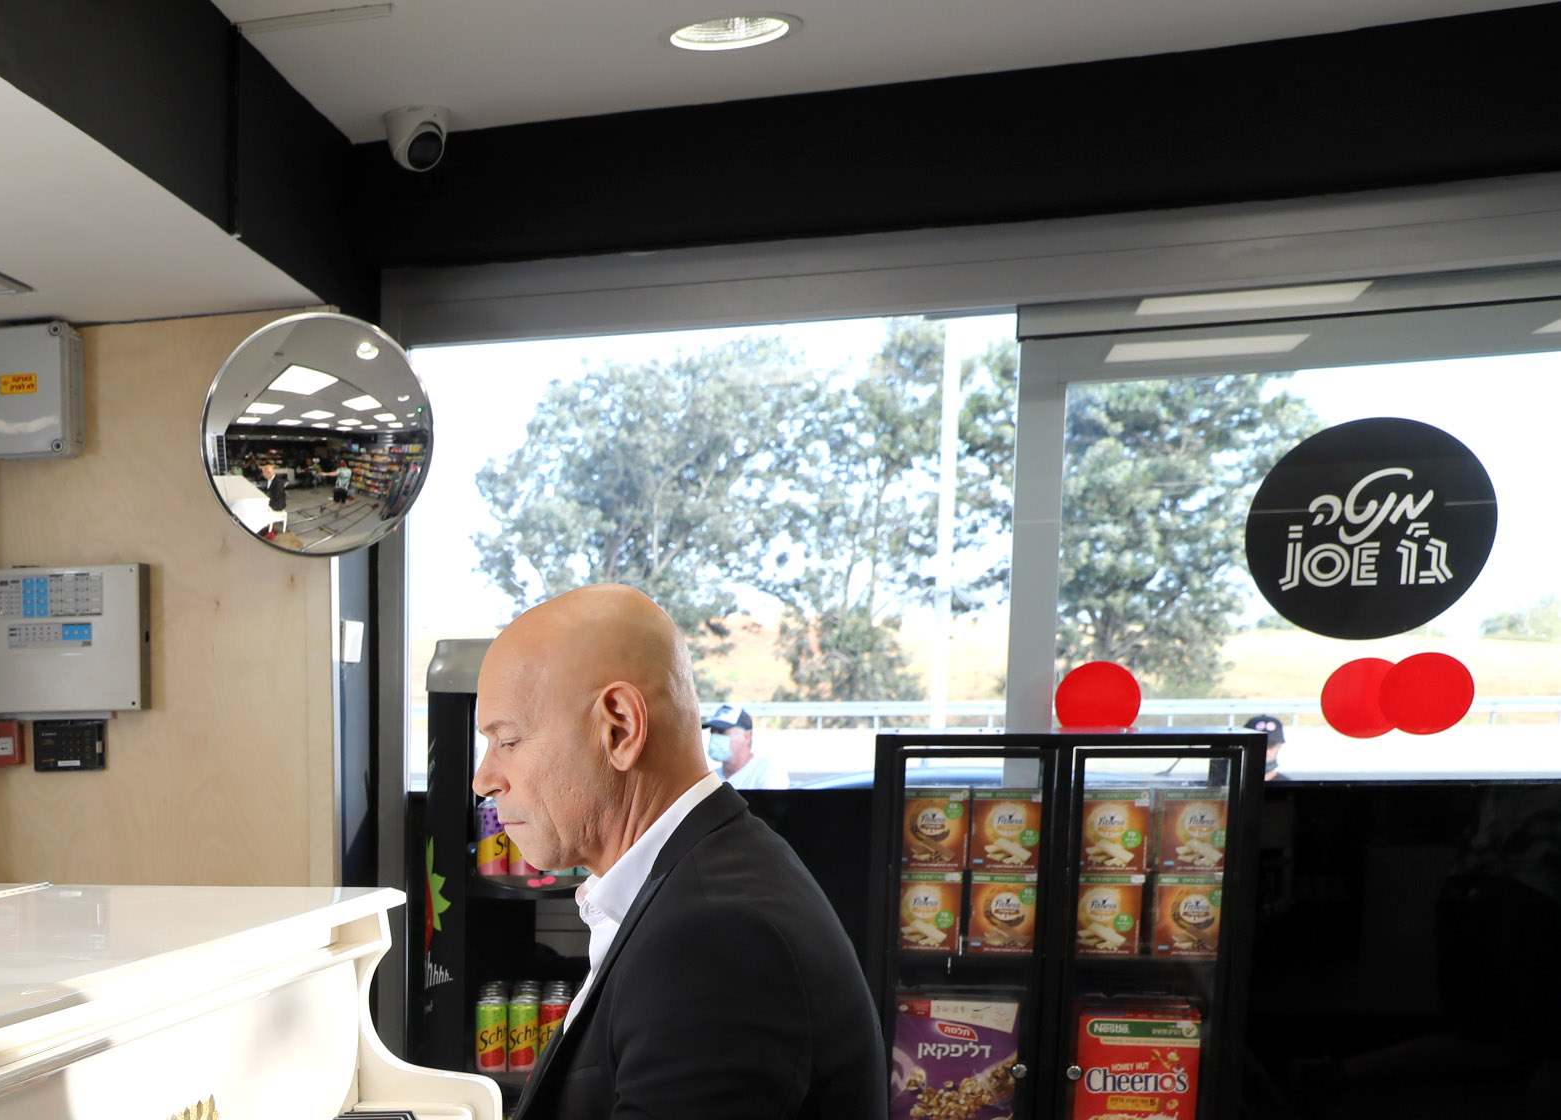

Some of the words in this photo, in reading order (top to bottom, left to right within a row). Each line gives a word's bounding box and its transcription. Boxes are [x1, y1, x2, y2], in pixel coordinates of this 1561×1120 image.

[921, 814, 946, 824] Fitness
[997, 814, 1022, 825] Fitness
[1098, 816, 1125, 826] Fitness
[1188, 815, 1215, 825] Fitness
[913, 897, 938, 907] Fitness
[995, 899, 1020, 909] Fitness
[1090, 899, 1117, 910] Fitness
[1184, 901, 1210, 911] Fitness
[944, 1025, 970, 1037] תלמה
[918, 1041, 992, 1060] דליפקאן
[1136, 1061, 1150, 1070] NUT
[1085, 1066, 1189, 1093] Cheerios
